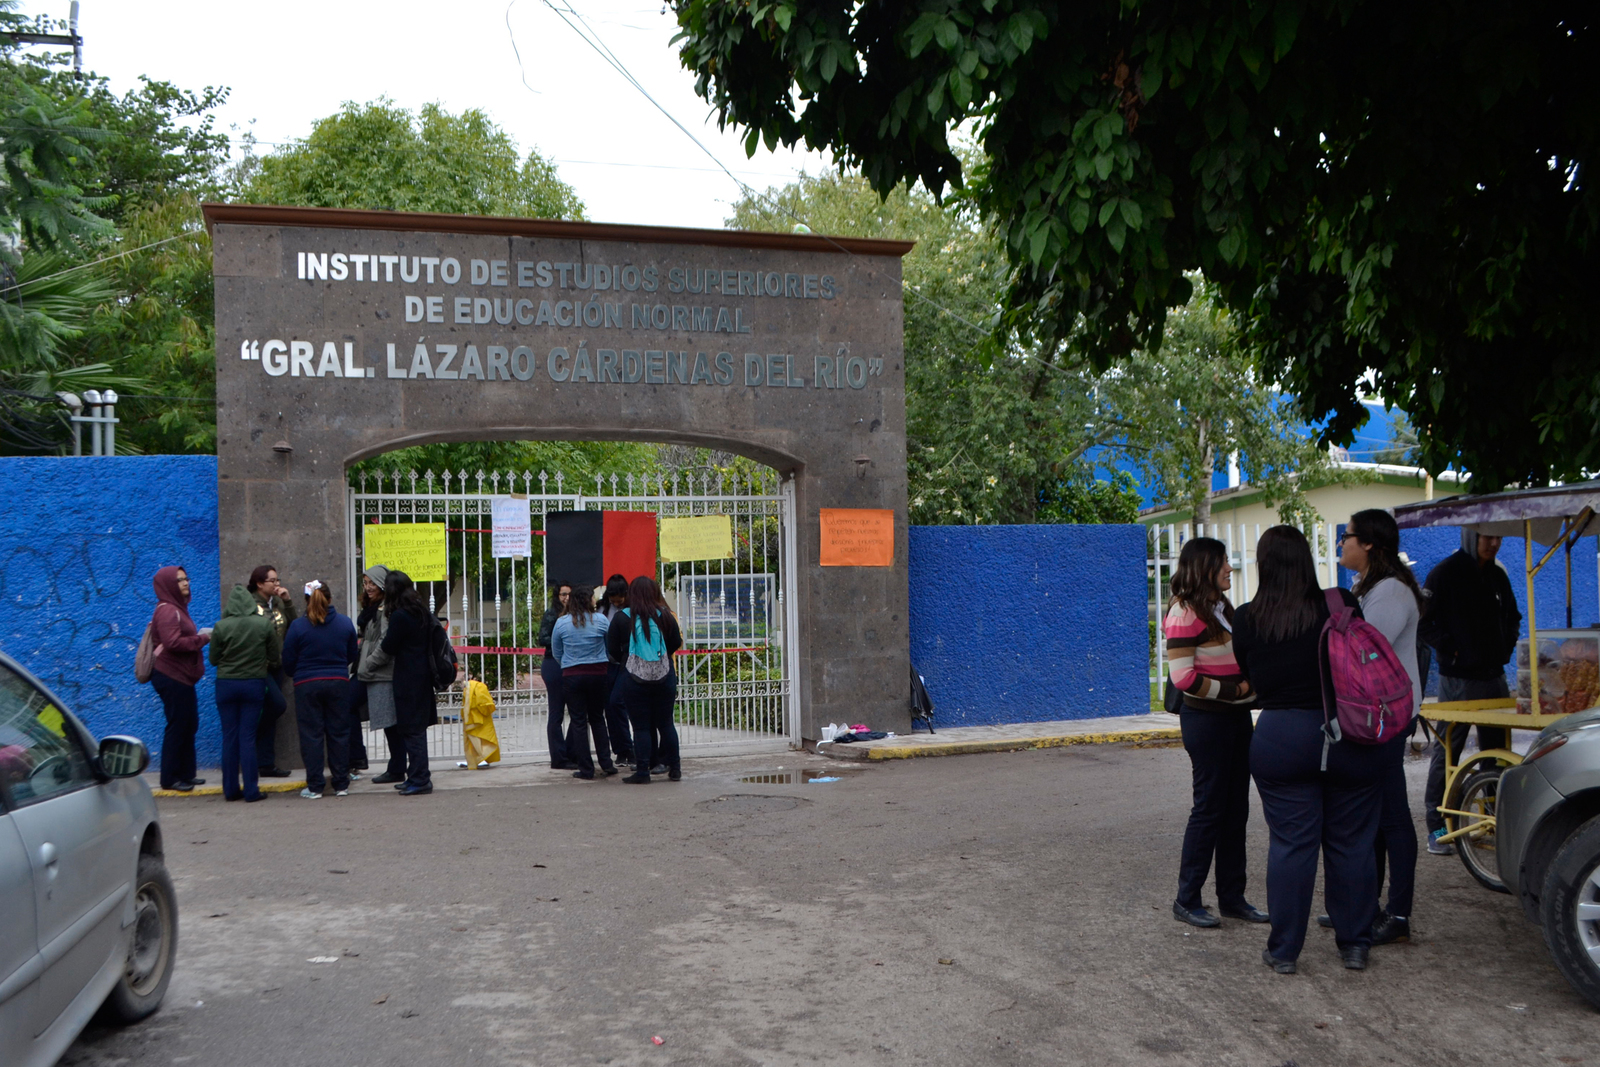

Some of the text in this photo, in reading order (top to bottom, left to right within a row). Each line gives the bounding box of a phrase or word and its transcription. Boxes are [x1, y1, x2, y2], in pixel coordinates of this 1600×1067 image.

[297, 252, 837, 300] INSTITUTO DE ESTUDIOS SUPERIORES
[405, 294, 751, 334] DE EDUCACIÓN NORMAL
[240, 335, 885, 391] “GRAL. LÁZARO CÁRDENAS DEL RÍO”
[370, 539, 382, 549] los
[378, 527, 410, 538] tampoco
[371, 552, 380, 560] de
[382, 550, 393, 558] los
